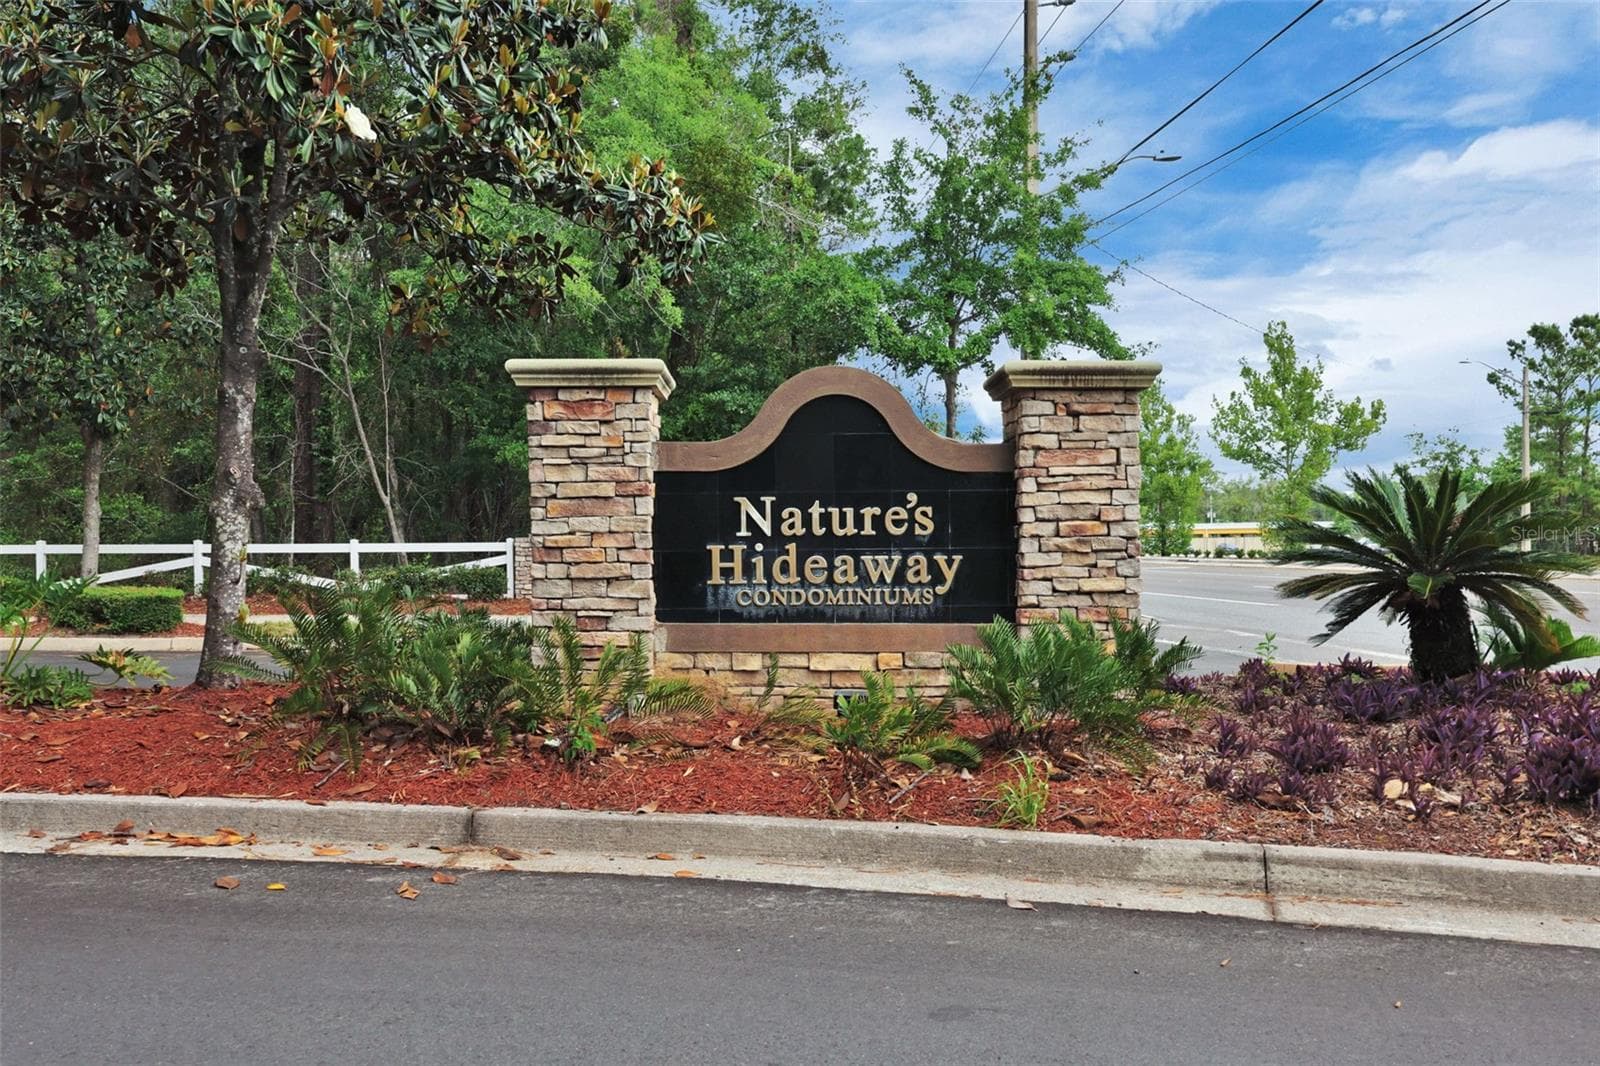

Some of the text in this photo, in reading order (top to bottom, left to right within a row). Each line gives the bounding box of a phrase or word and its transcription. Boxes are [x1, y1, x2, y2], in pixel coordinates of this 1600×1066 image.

[733, 492, 935, 537] Nature's
[706, 542, 963, 595] Hideaway
[736, 588, 935, 607] CONDOMINIUMS
